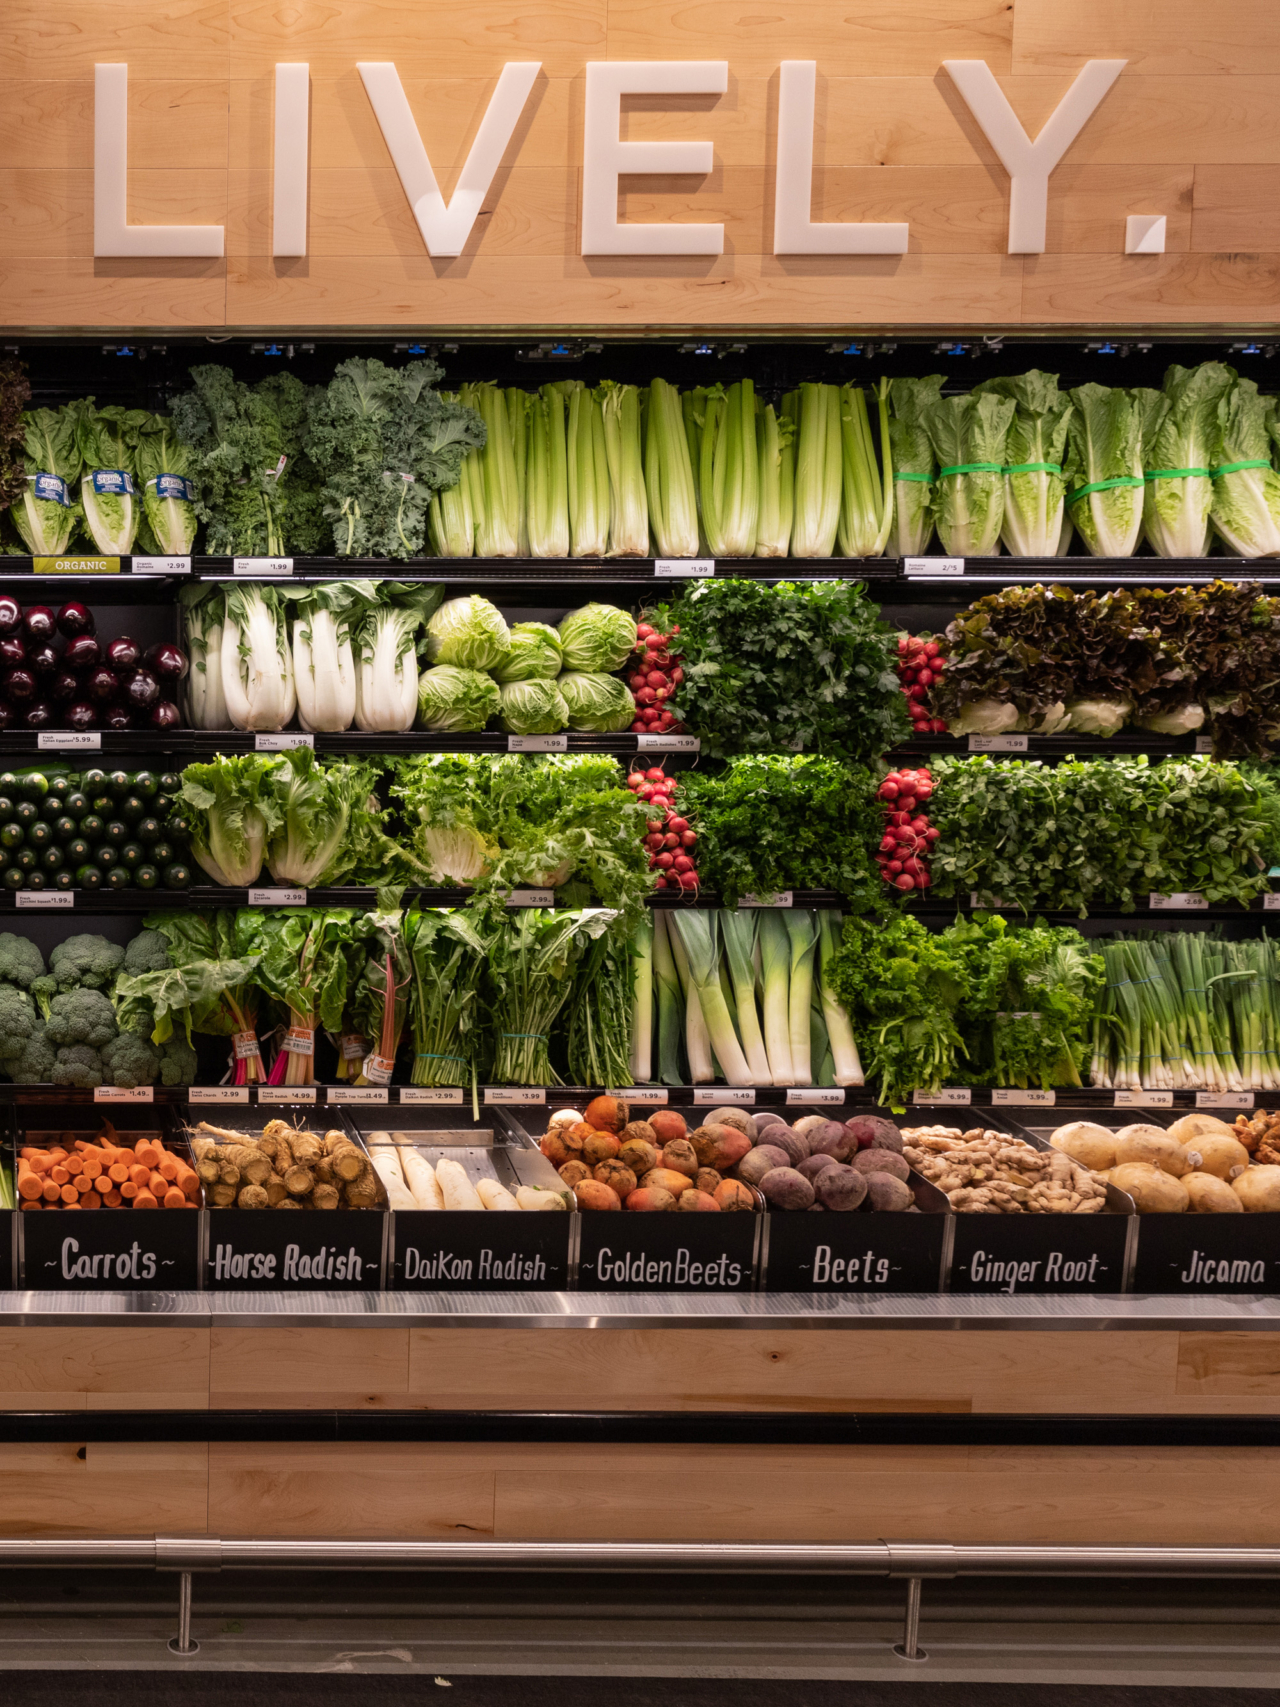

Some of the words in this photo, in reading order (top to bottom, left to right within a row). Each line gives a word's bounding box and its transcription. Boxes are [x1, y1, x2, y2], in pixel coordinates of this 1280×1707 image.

[94, 60, 1167, 258] LIVELY.
[56, 561, 106, 570] ORGANIC
[61, 1237, 157, 1279] Carrots
[215, 1244, 276, 1279] Horse
[283, 1244, 362, 1280] Radish
[479, 1249, 546, 1280] Radish
[813, 1245, 890, 1284] Beets
[970, 1250, 1042, 1293] Ginger
[1045, 1252, 1099, 1282] Root
[1182, 1250, 1264, 1283] Jicama
